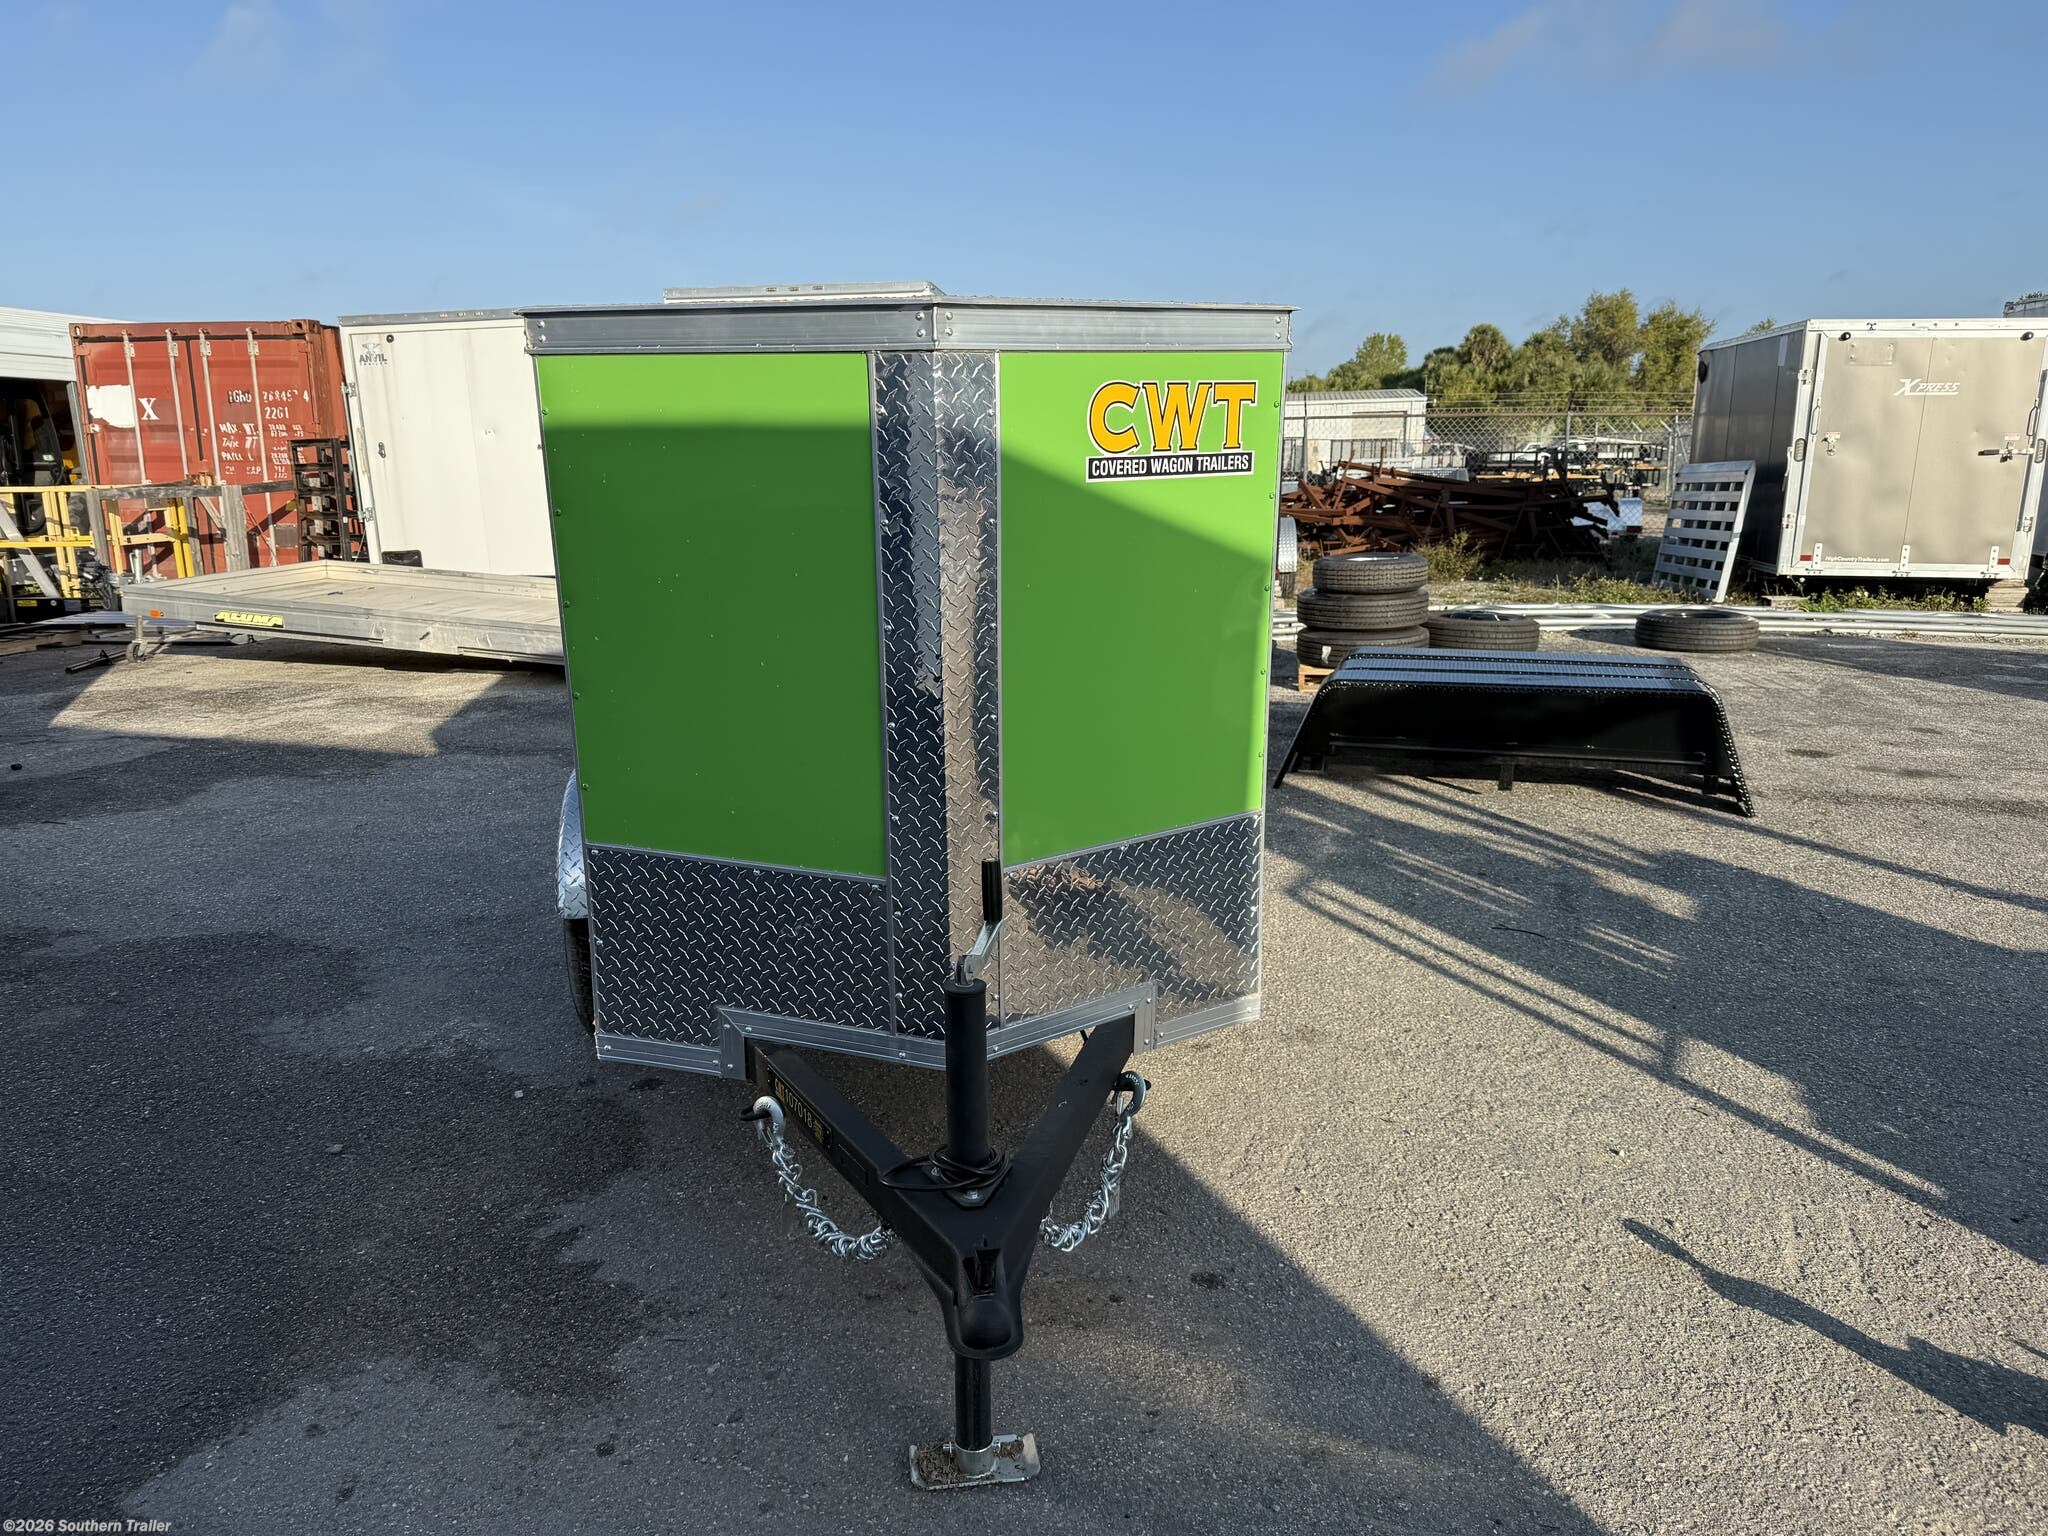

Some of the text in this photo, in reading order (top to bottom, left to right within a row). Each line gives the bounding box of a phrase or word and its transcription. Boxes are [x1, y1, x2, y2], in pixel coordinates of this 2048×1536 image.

[359, 353, 387, 362] ANVIL
[303, 389, 310, 403] 4
[137, 397, 161, 420] X
[1088, 381, 1257, 454] CWT
[1091, 454, 1249, 477] COVERED WAGON TRAILERS
[215, 611, 283, 627] ALUMA
[785, 1089, 813, 1128] 107018
